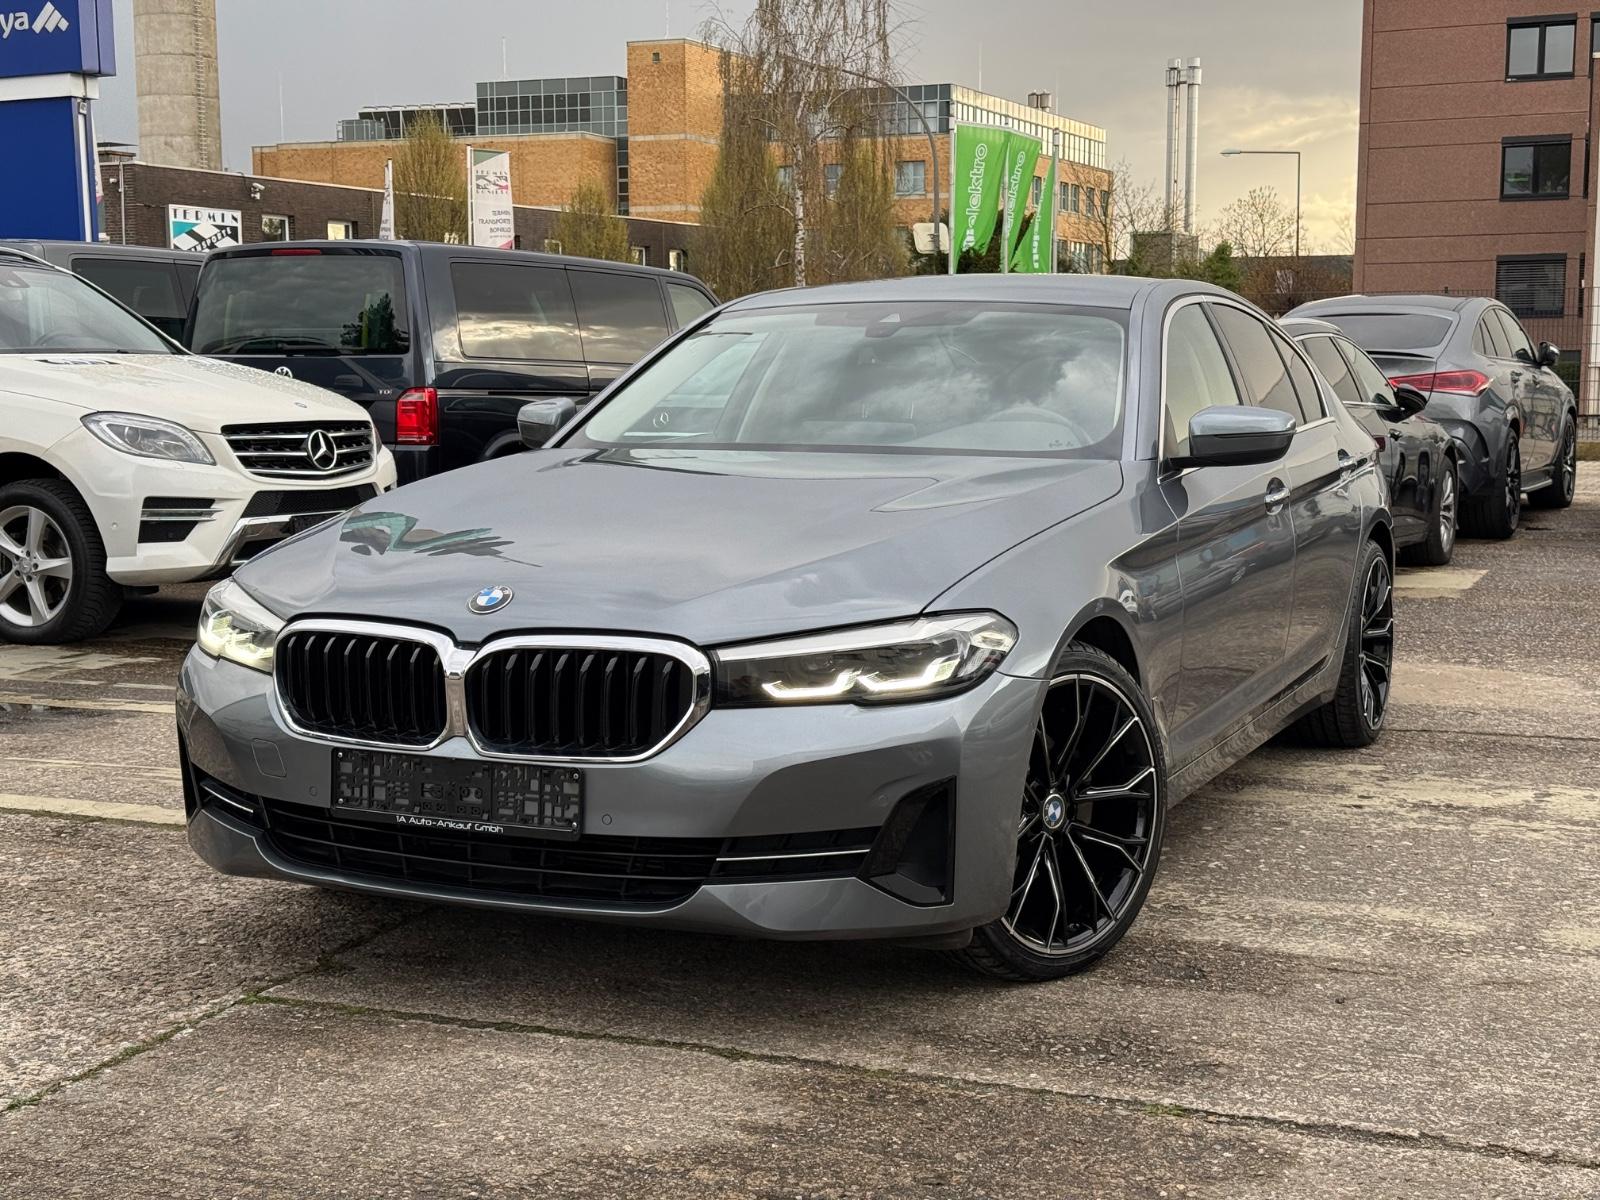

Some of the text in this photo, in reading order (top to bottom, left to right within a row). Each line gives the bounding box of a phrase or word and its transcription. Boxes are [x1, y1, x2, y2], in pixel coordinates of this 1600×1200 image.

[0, 11, 29, 39] ya
[173, 208, 239, 224] TERMIN
[191, 226, 232, 252] NSPORTE
[395, 815, 407, 824] 1A
[408, 816, 472, 830] Auto-Ankauf
